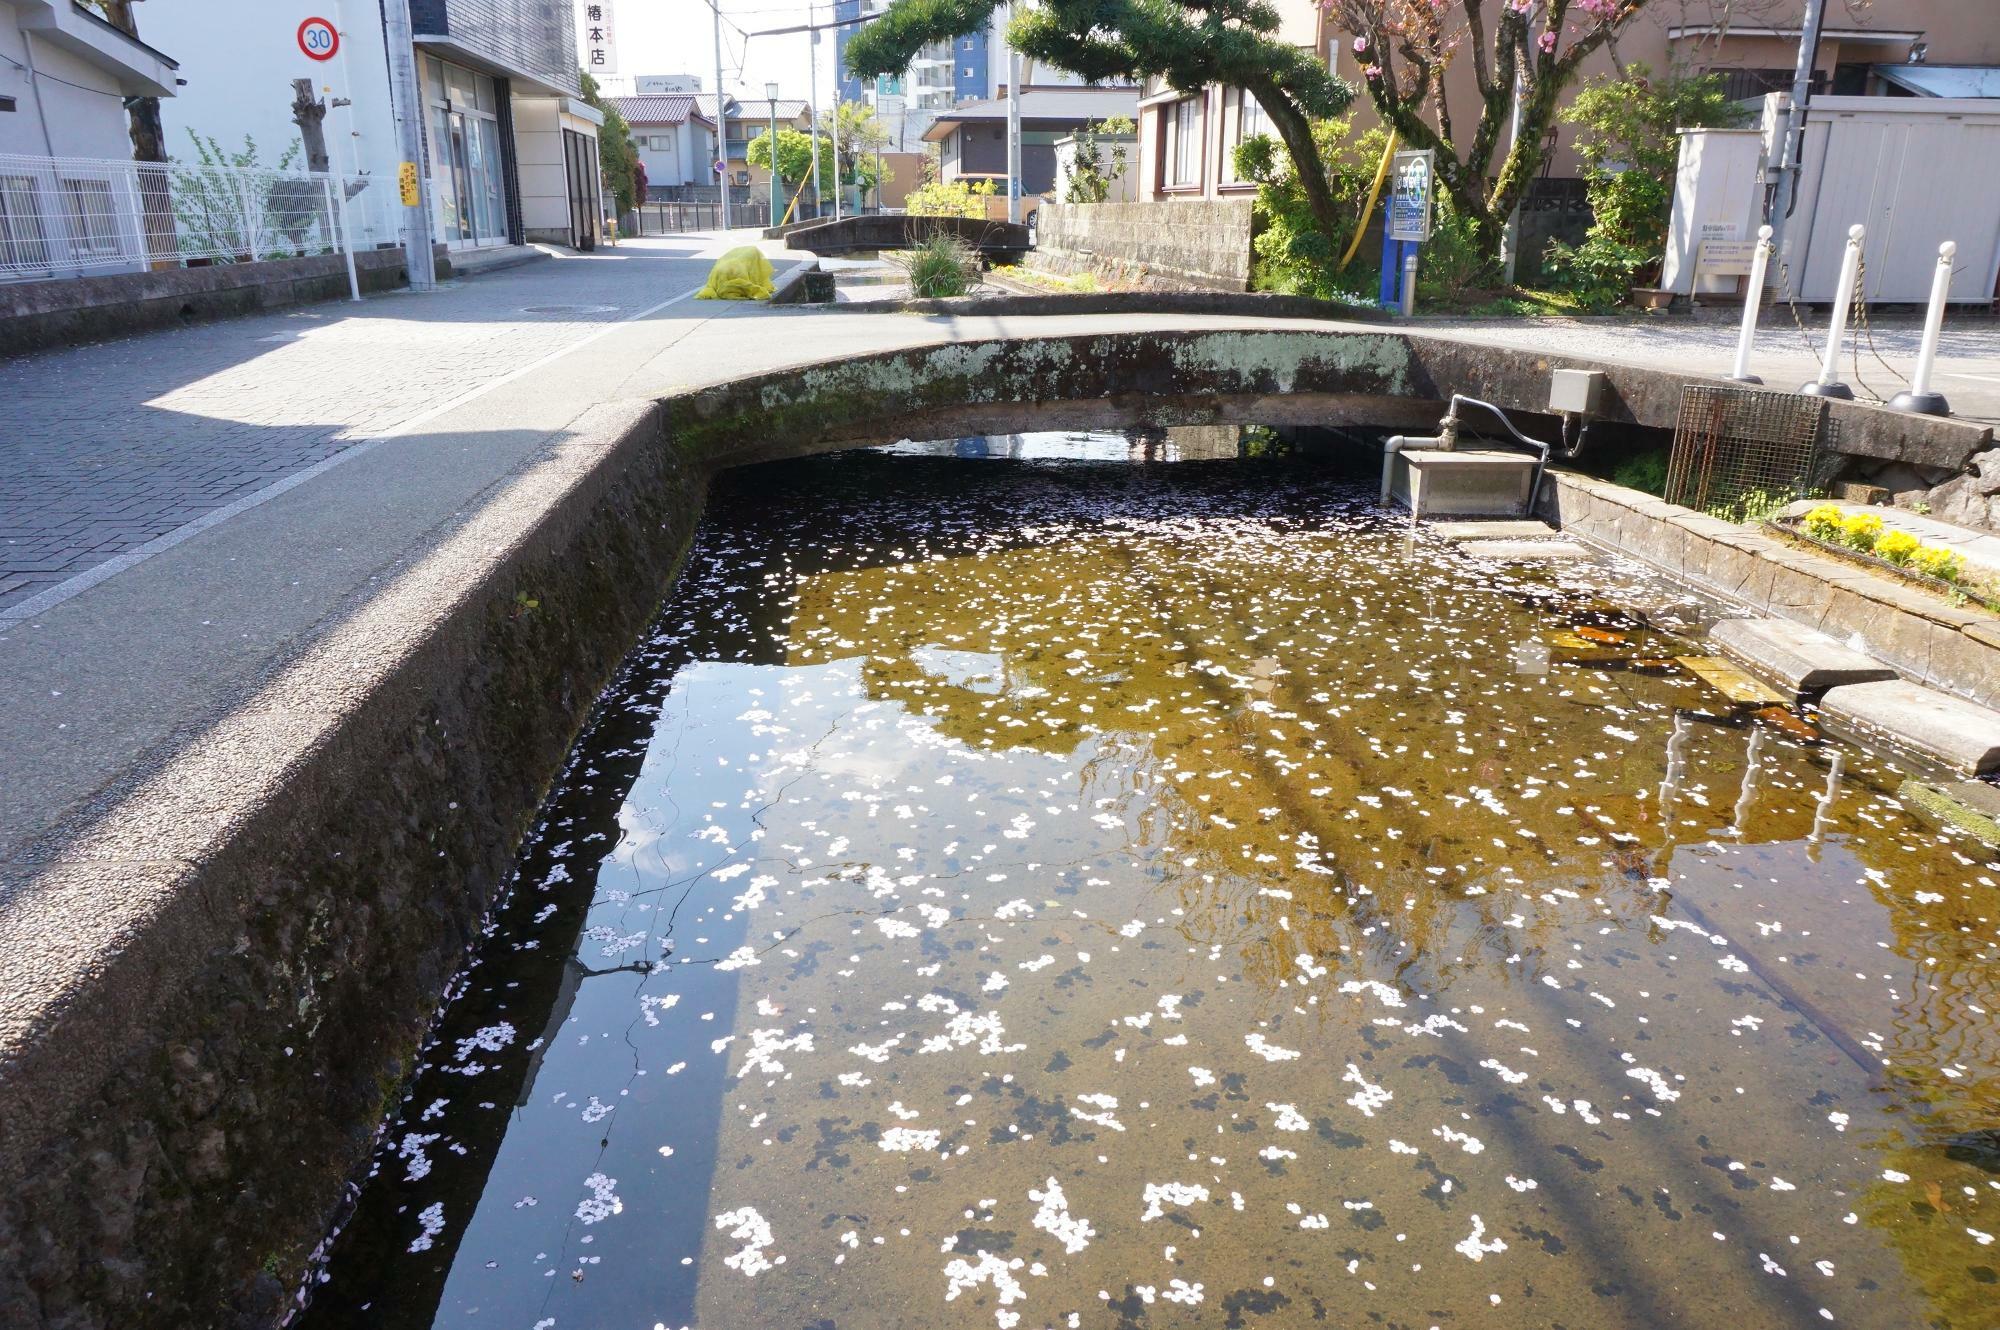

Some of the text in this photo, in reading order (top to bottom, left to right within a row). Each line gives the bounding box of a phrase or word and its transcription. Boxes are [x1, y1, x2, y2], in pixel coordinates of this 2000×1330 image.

[307, 30, 330, 48] 30
[587, 4, 605, 65] 椿本店
